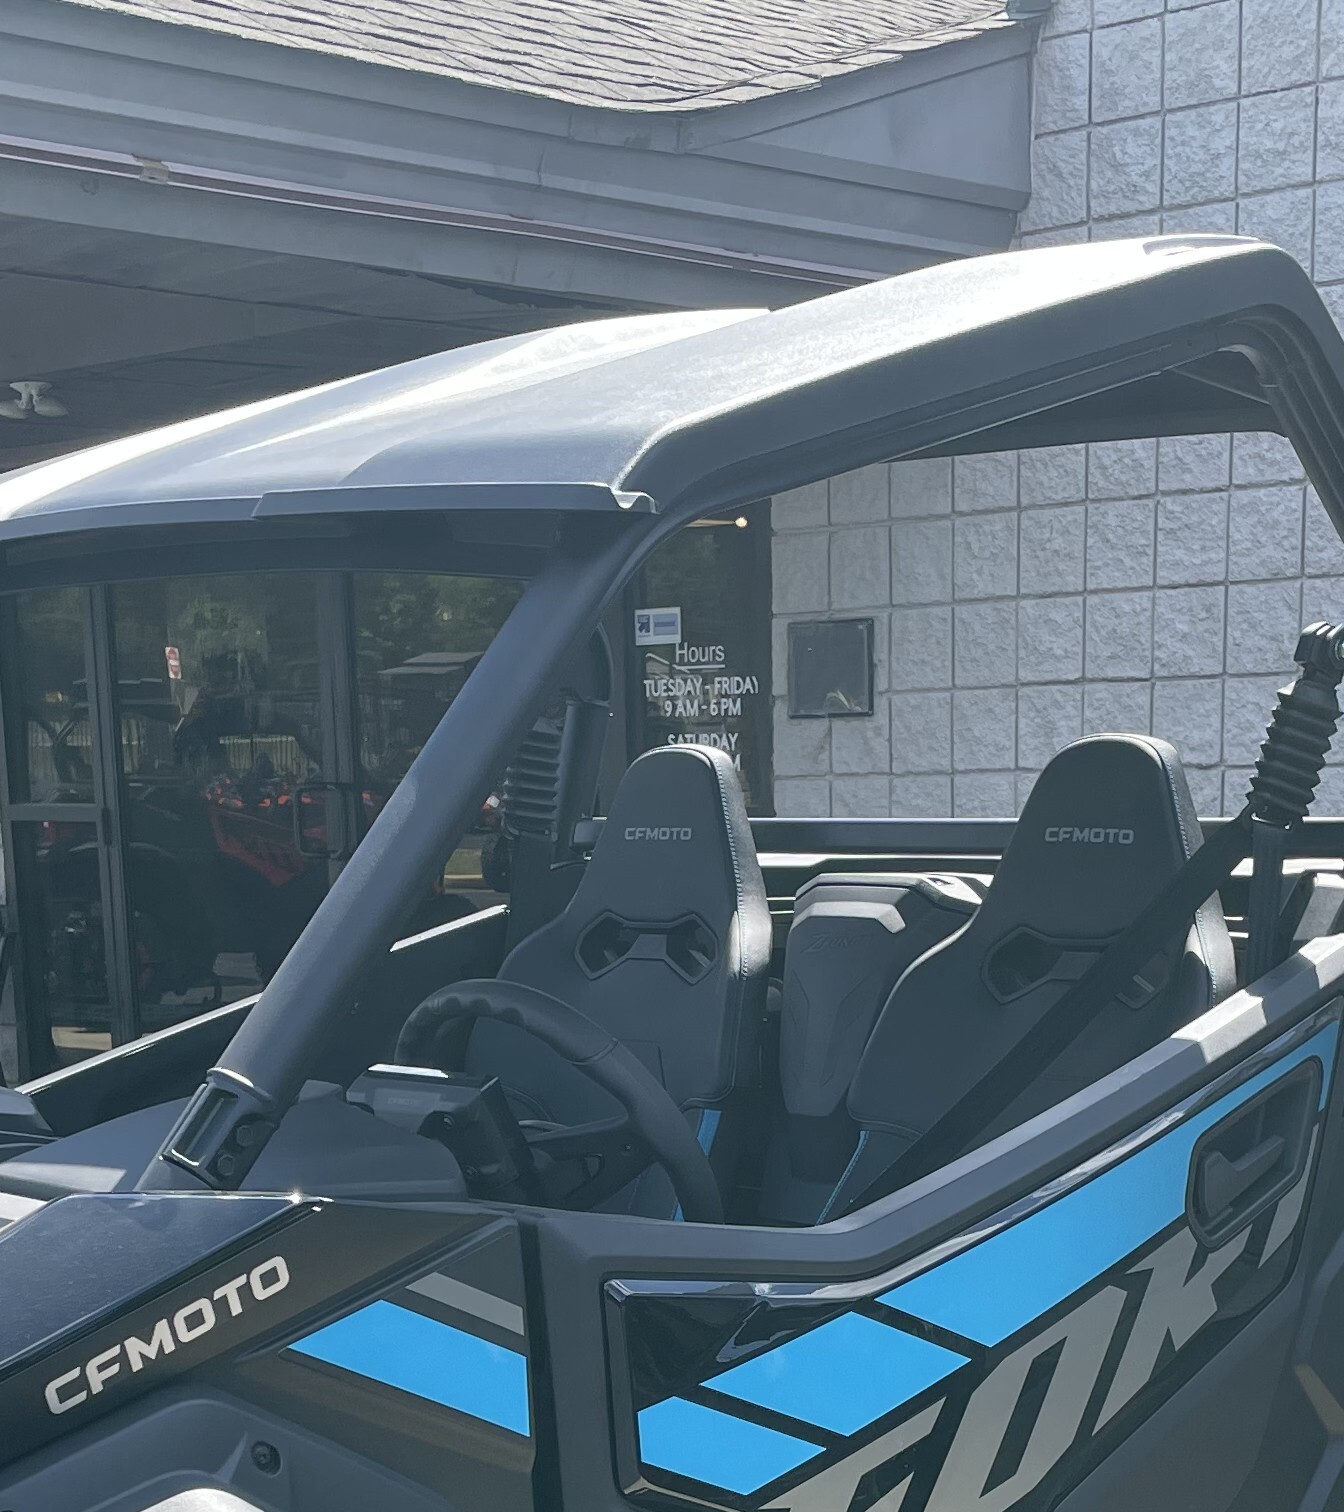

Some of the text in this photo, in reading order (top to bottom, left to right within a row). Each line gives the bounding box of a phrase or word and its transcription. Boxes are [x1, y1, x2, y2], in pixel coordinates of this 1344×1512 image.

[676, 642, 725, 663] Hours
[643, 678, 702, 697] TUESDAY
[664, 700, 672, 717] 9
[675, 699, 699, 717] AM
[710, 699, 718, 716] 6
[720, 698, 742, 716] PM
[624, 827, 692, 841] CFMOTO
[1044, 827, 1135, 844] CFMOTO
[44, 1255, 290, 1415] CFMOTO
